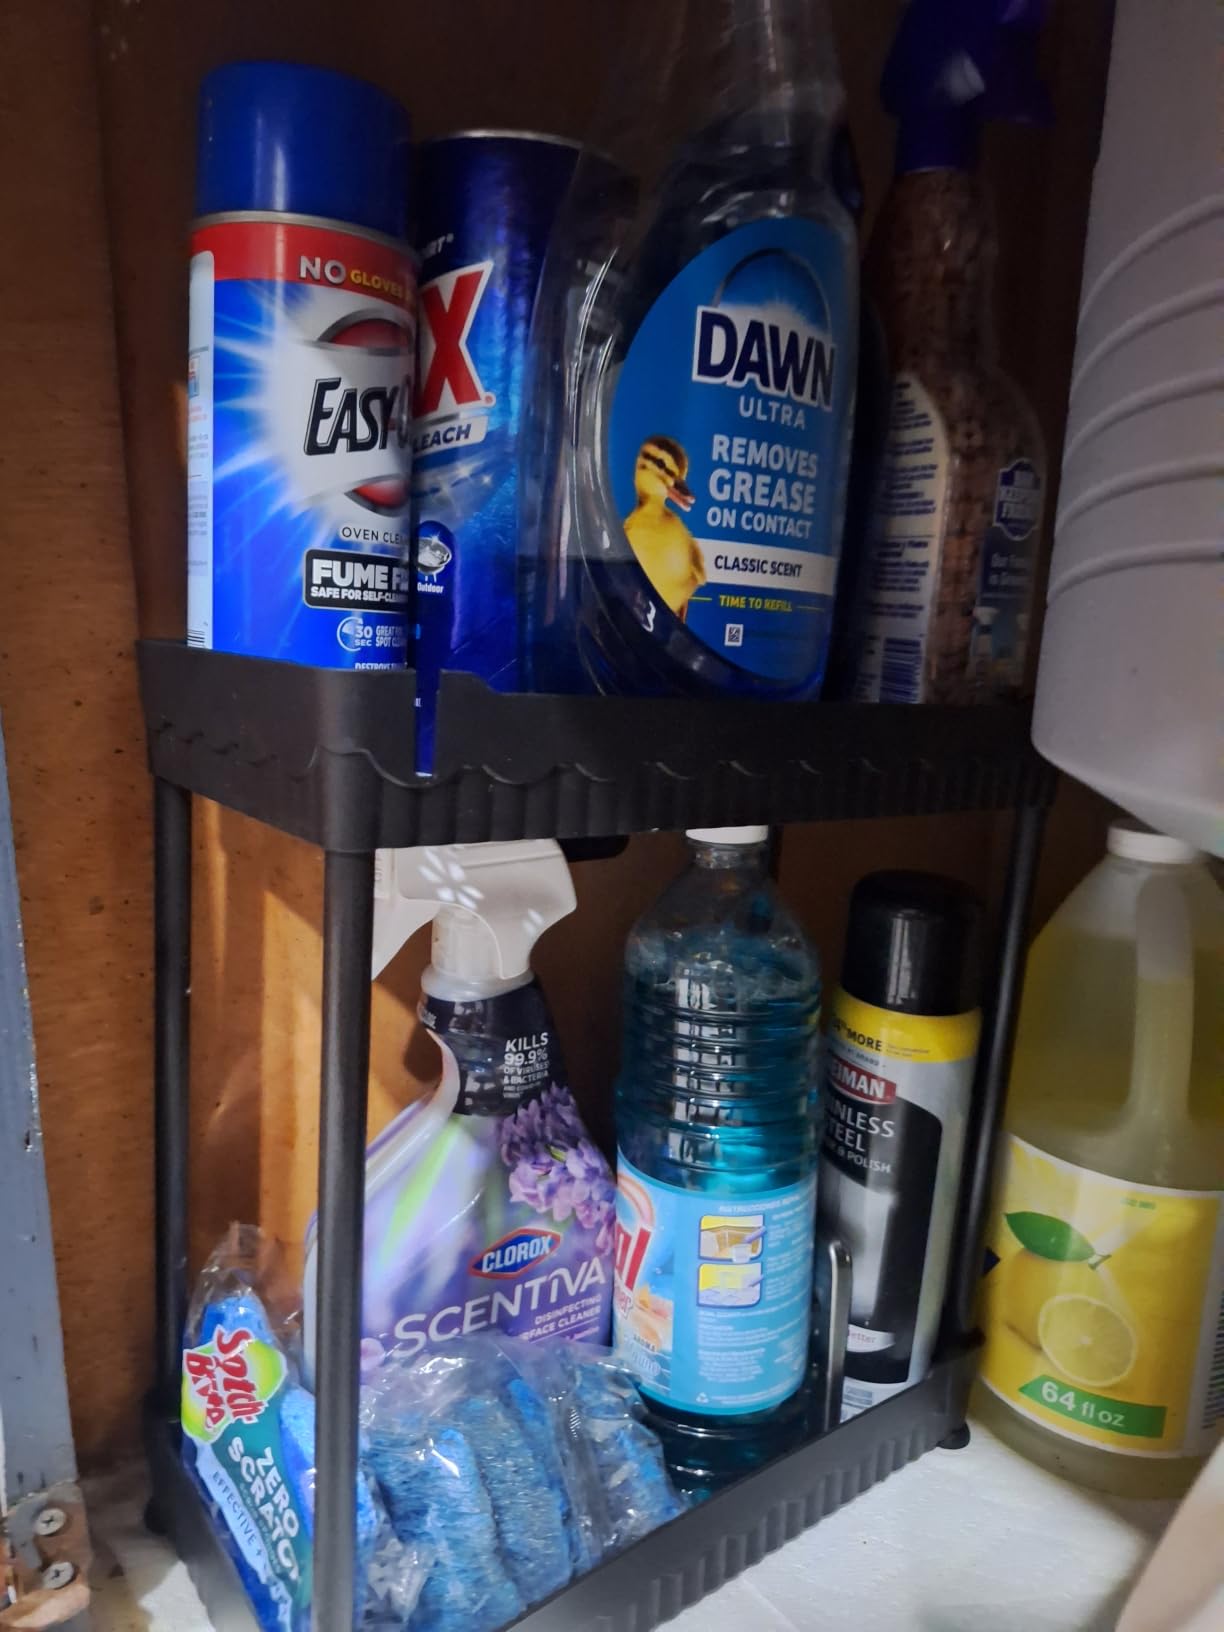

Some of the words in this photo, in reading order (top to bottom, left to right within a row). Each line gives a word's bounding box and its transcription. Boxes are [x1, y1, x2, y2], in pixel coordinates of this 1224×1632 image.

[300, 255, 347, 285] NO
[696, 308, 836, 410] DAWN
[739, 395, 806, 430] ULTRA
[414, 423, 472, 450] LEACH
[712, 433, 818, 478] REMOVES
[708, 468, 817, 515] GREASE
[341, 525, 380, 542] OVEN
[383, 532, 406, 545] CLE
[706, 506, 737, 529] ON
[741, 511, 813, 539] CONTACT
[312, 557, 390, 591] FUME
[714, 554, 769, 575] CLASSIC
[769, 560, 803, 578] SCENT
[310, 585, 340, 600] SAFE
[341, 588, 362, 601] FOR
[719, 594, 746, 609] TIME
[749, 598, 762, 610] TO
[354, 624, 373, 639] 30
[354, 638, 373, 648] SEC
[503, 1047, 549, 1066] 99.9%
[505, 1032, 549, 1052] KILLS
[831, 1059, 886, 1100] EIMAN
[847, 1150, 893, 1174] POLISH
[481, 1235, 552, 1273] CLOROX
[393, 1256, 606, 1358] SCENTIVA
[519, 1321, 557, 1342] RFACE
[1041, 1381, 1076, 1412] 64
[1081, 1400, 1095, 1418] fl
[1097, 1408, 1126, 1428] oz
[256, 1446, 300, 1538] ZERO
[212, 1470, 258, 1547] EFFECTIVE
